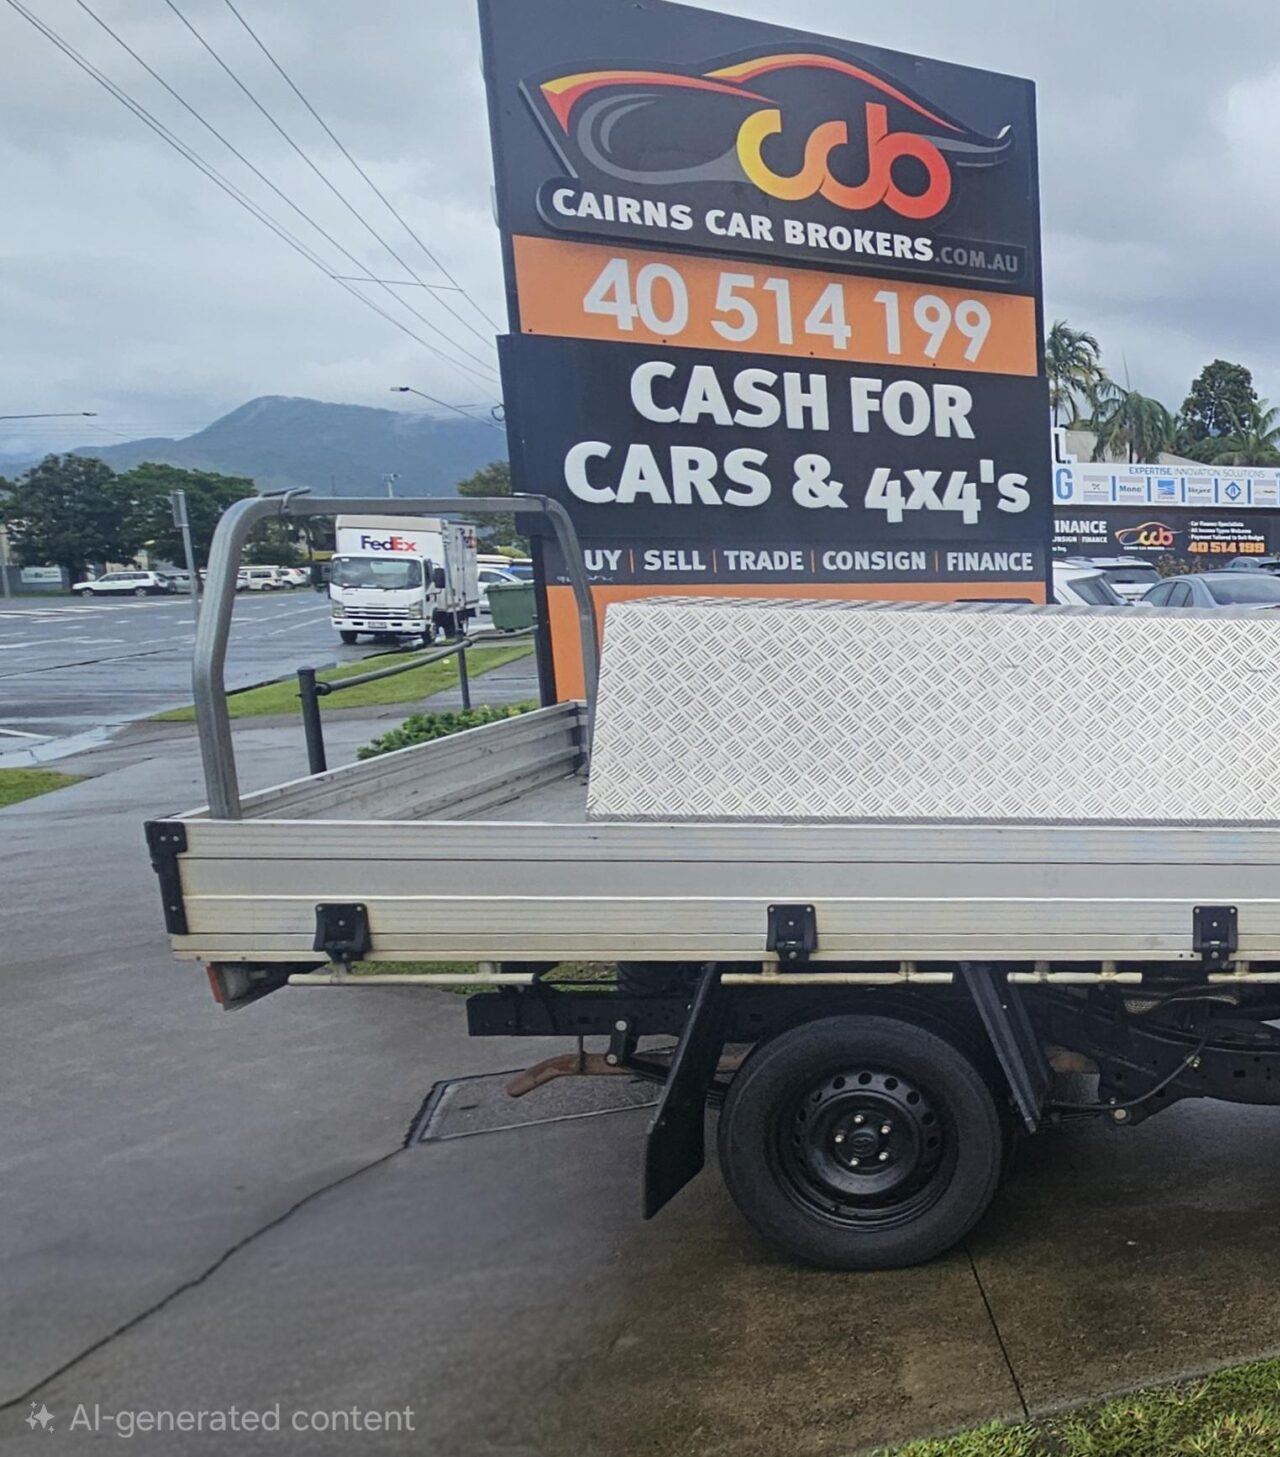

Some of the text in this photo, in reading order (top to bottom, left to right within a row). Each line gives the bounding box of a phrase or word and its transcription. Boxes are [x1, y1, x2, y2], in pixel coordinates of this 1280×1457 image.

[552, 188, 693, 231] CAIRNS
[705, 209, 773, 242] CAR
[583, 258, 992, 363] 40 514 199
[630, 361, 975, 439] CASH FOR
[564, 441, 772, 507] CARS
[793, 454, 848, 509] &
[1129, 466, 1172, 475] EXPERTISE
[1054, 520, 1107, 533] INANCE
[361, 535, 416, 551] FedEx
[1187, 542, 1209, 552] 40
[1210, 542, 1237, 553] 514
[583, 549, 1033, 572] UY SELL TRADE CONSIGN FINANCE
